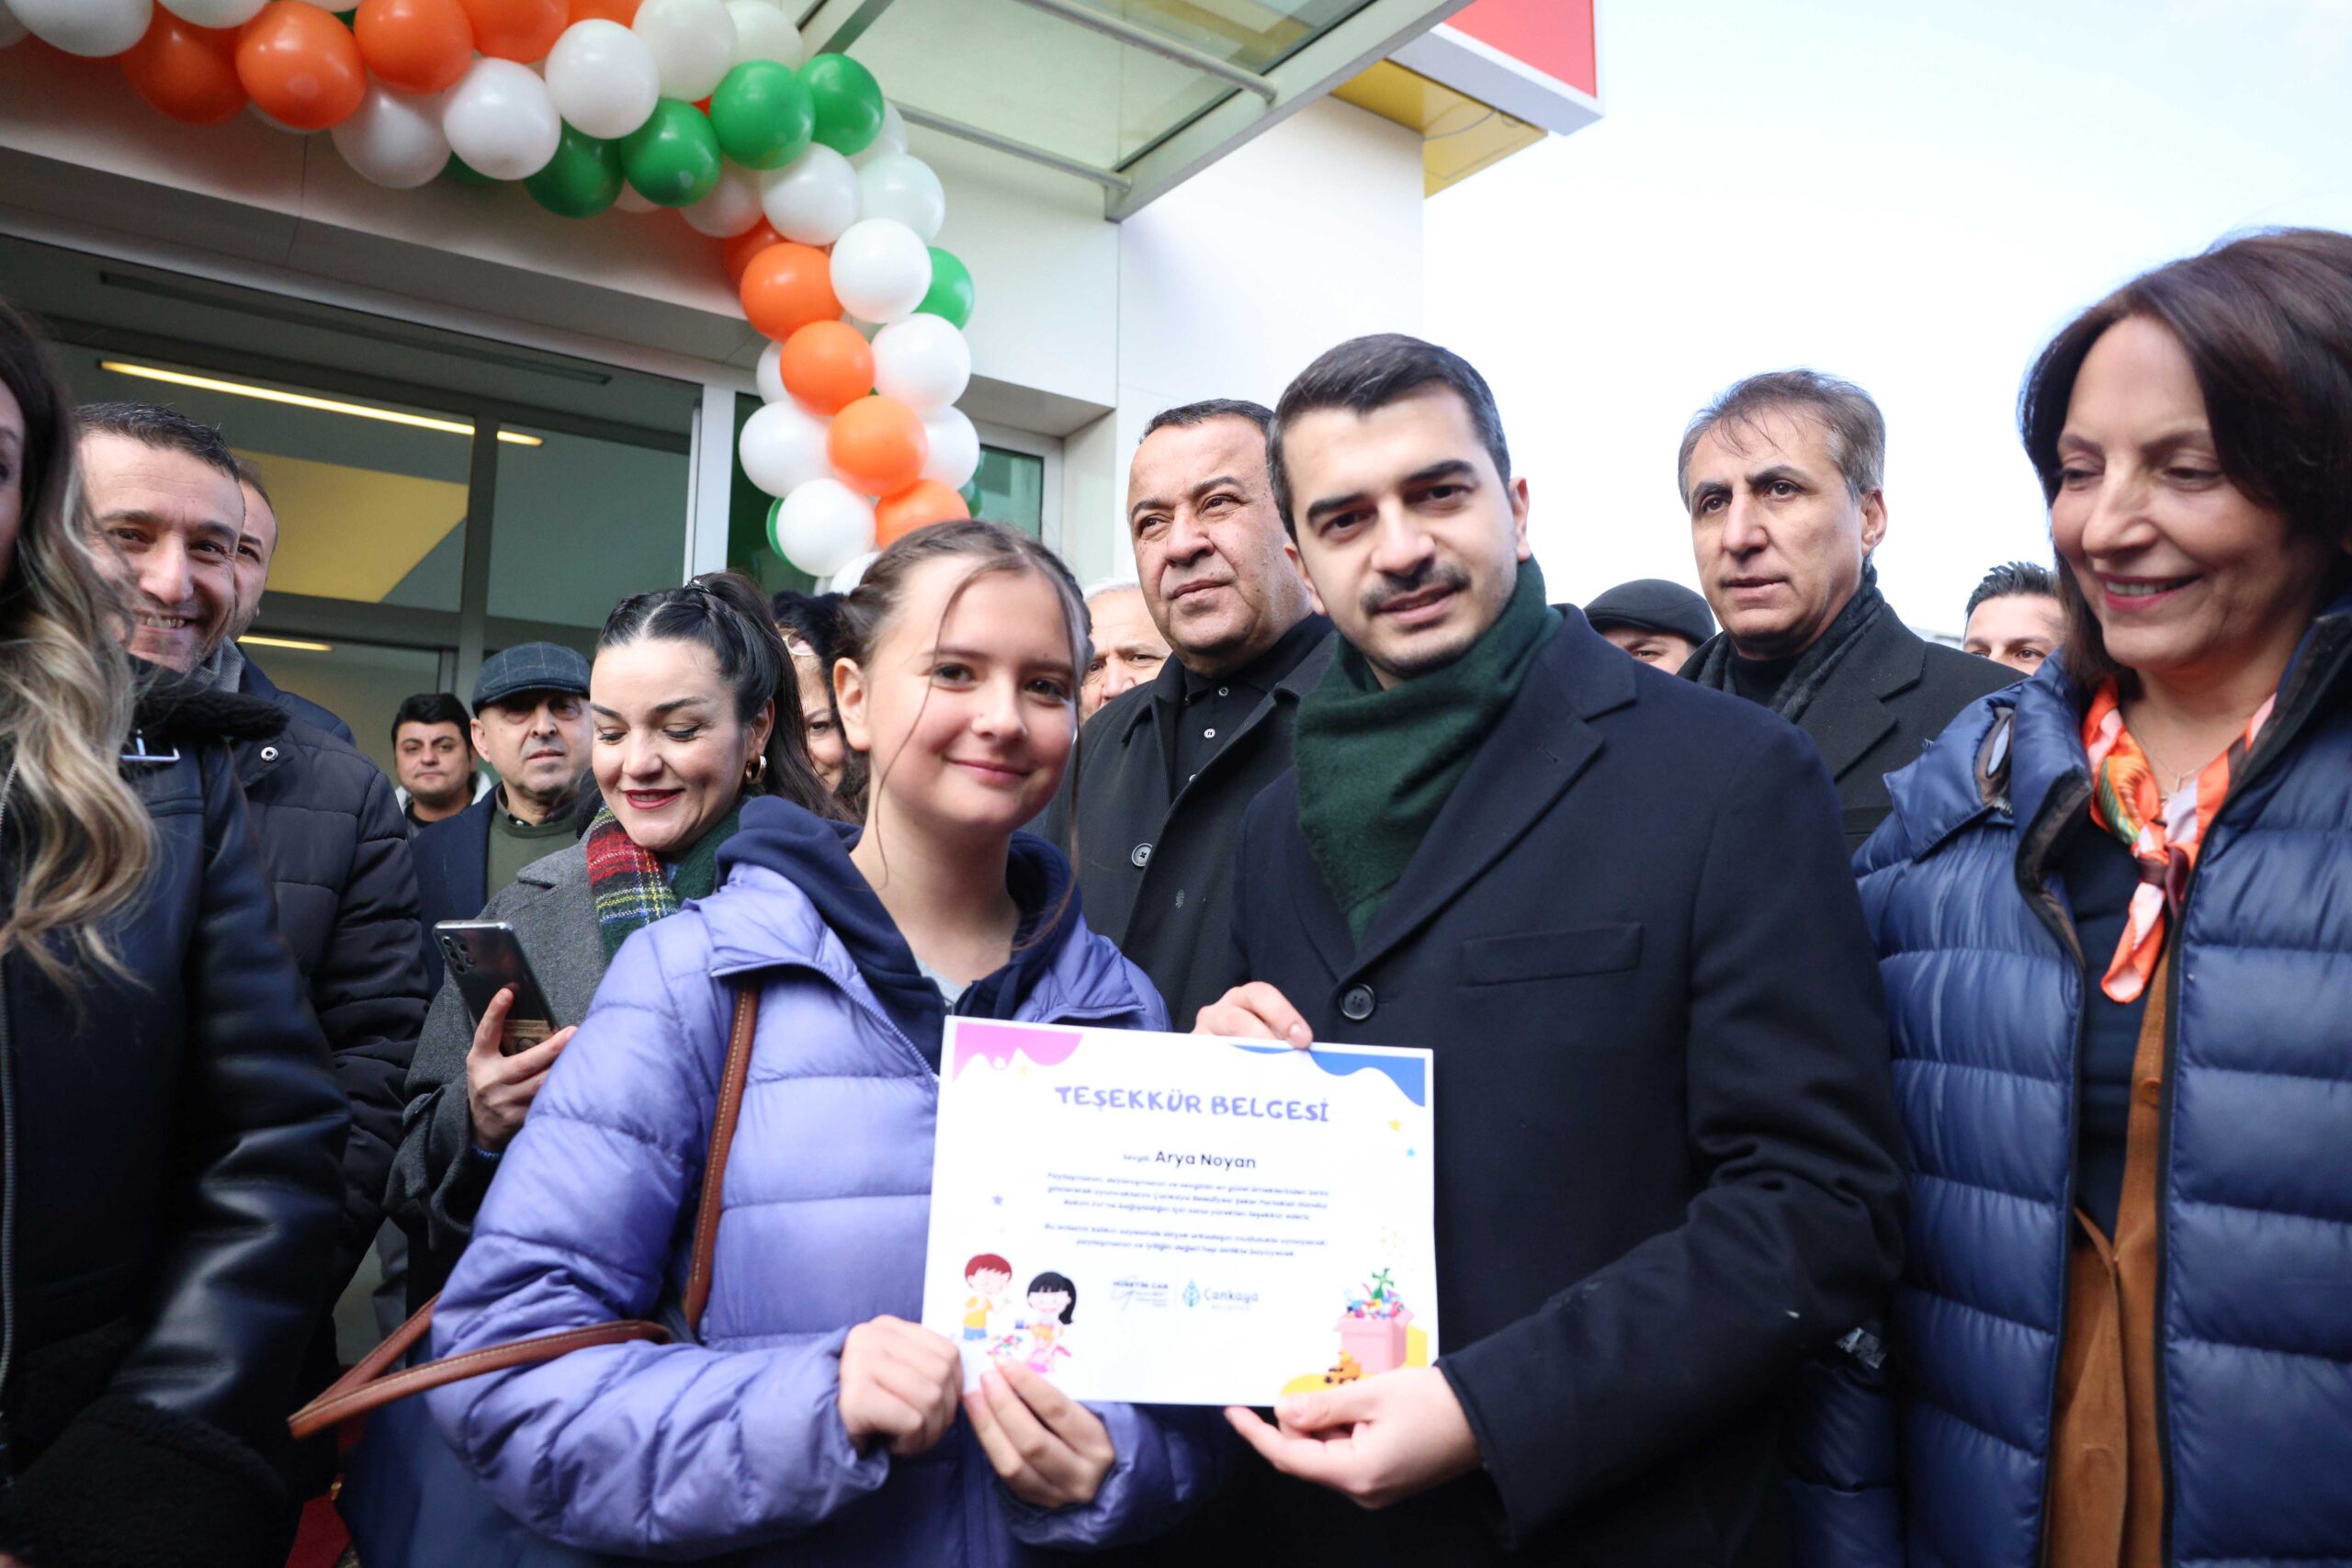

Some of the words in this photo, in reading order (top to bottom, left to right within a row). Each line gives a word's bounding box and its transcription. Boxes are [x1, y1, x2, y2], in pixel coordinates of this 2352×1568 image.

[1055, 1086, 1202, 1113] TEŞEKKÜR
[1211, 1096, 1329, 1122] BELGESİ
[1155, 1150, 1195, 1168] Arya
[1200, 1154, 1256, 1171] Noyan
